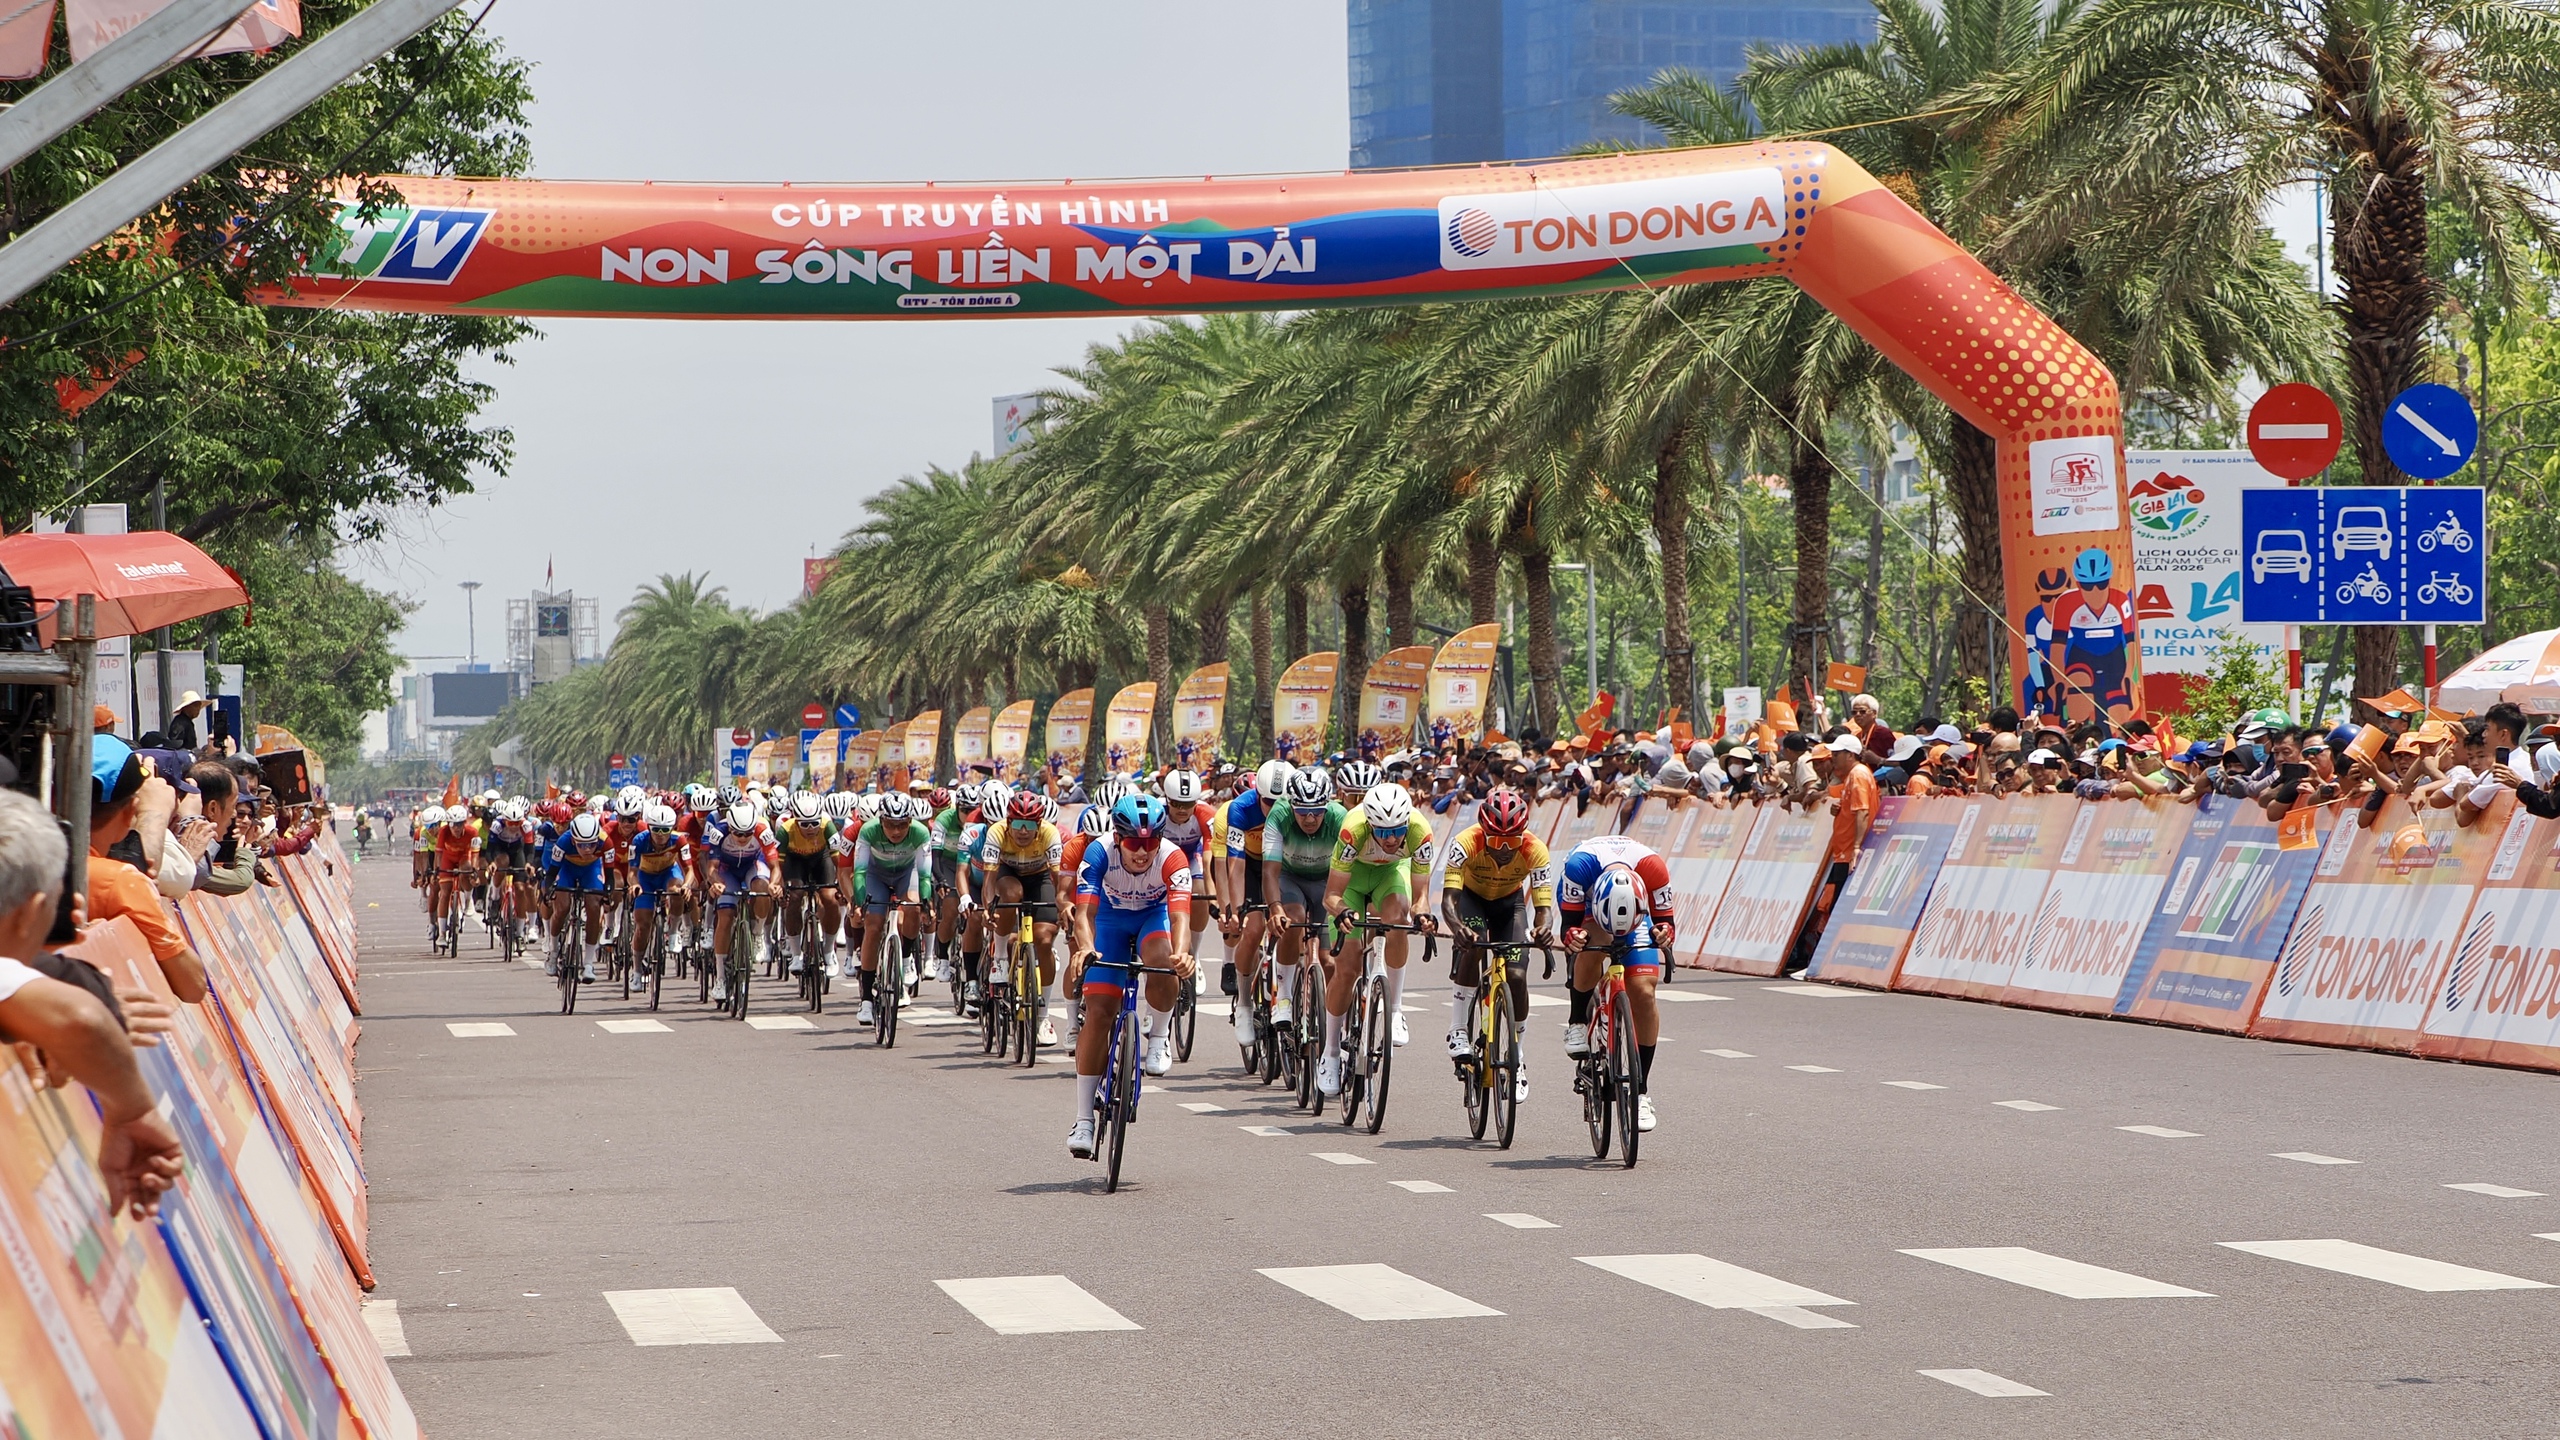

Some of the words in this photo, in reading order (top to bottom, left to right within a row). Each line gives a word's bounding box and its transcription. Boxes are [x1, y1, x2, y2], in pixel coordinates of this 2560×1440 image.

[771, 198, 862, 228] CÚP
[876, 194, 1043, 228] TRUYỀN
[1060, 195, 1169, 225] HÌNH
[1503, 214, 1598, 254] TON
[1608, 200, 1736, 246] DONG
[1743, 196, 1777, 232] A
[601, 246, 729, 284] NON
[755, 237, 913, 291] SÔNG
[937, 230, 1051, 284] LIỀN
[1075, 233, 1202, 288] MỘT
[1228, 226, 1317, 282] DẢI
[903, 298, 929, 306] HTV
[940, 296, 966, 306] TÔN
[2041, 506, 2070, 518] HTV
[2140, 500, 2166, 515] GIA
[2168, 491, 2185, 511] LAI
[2176, 545, 2219, 556] QUỐC
[115, 560, 188, 579] talentnet
[2186, 571, 2240, 622] LA
[2140, 640, 2196, 657] BIỂN
[2472, 659, 2531, 672] HTV
[2265, 715, 2284, 725] Grab
[1930, 908, 1974, 960] TON
[1958, 909, 2016, 965] DONG
[2040, 917, 2091, 973] TON
[2069, 919, 2129, 976] DONG
[2303, 935, 2365, 1000] TON
[2350, 938, 2426, 1003] DONG
[2473, 944, 2544, 1015] TON
